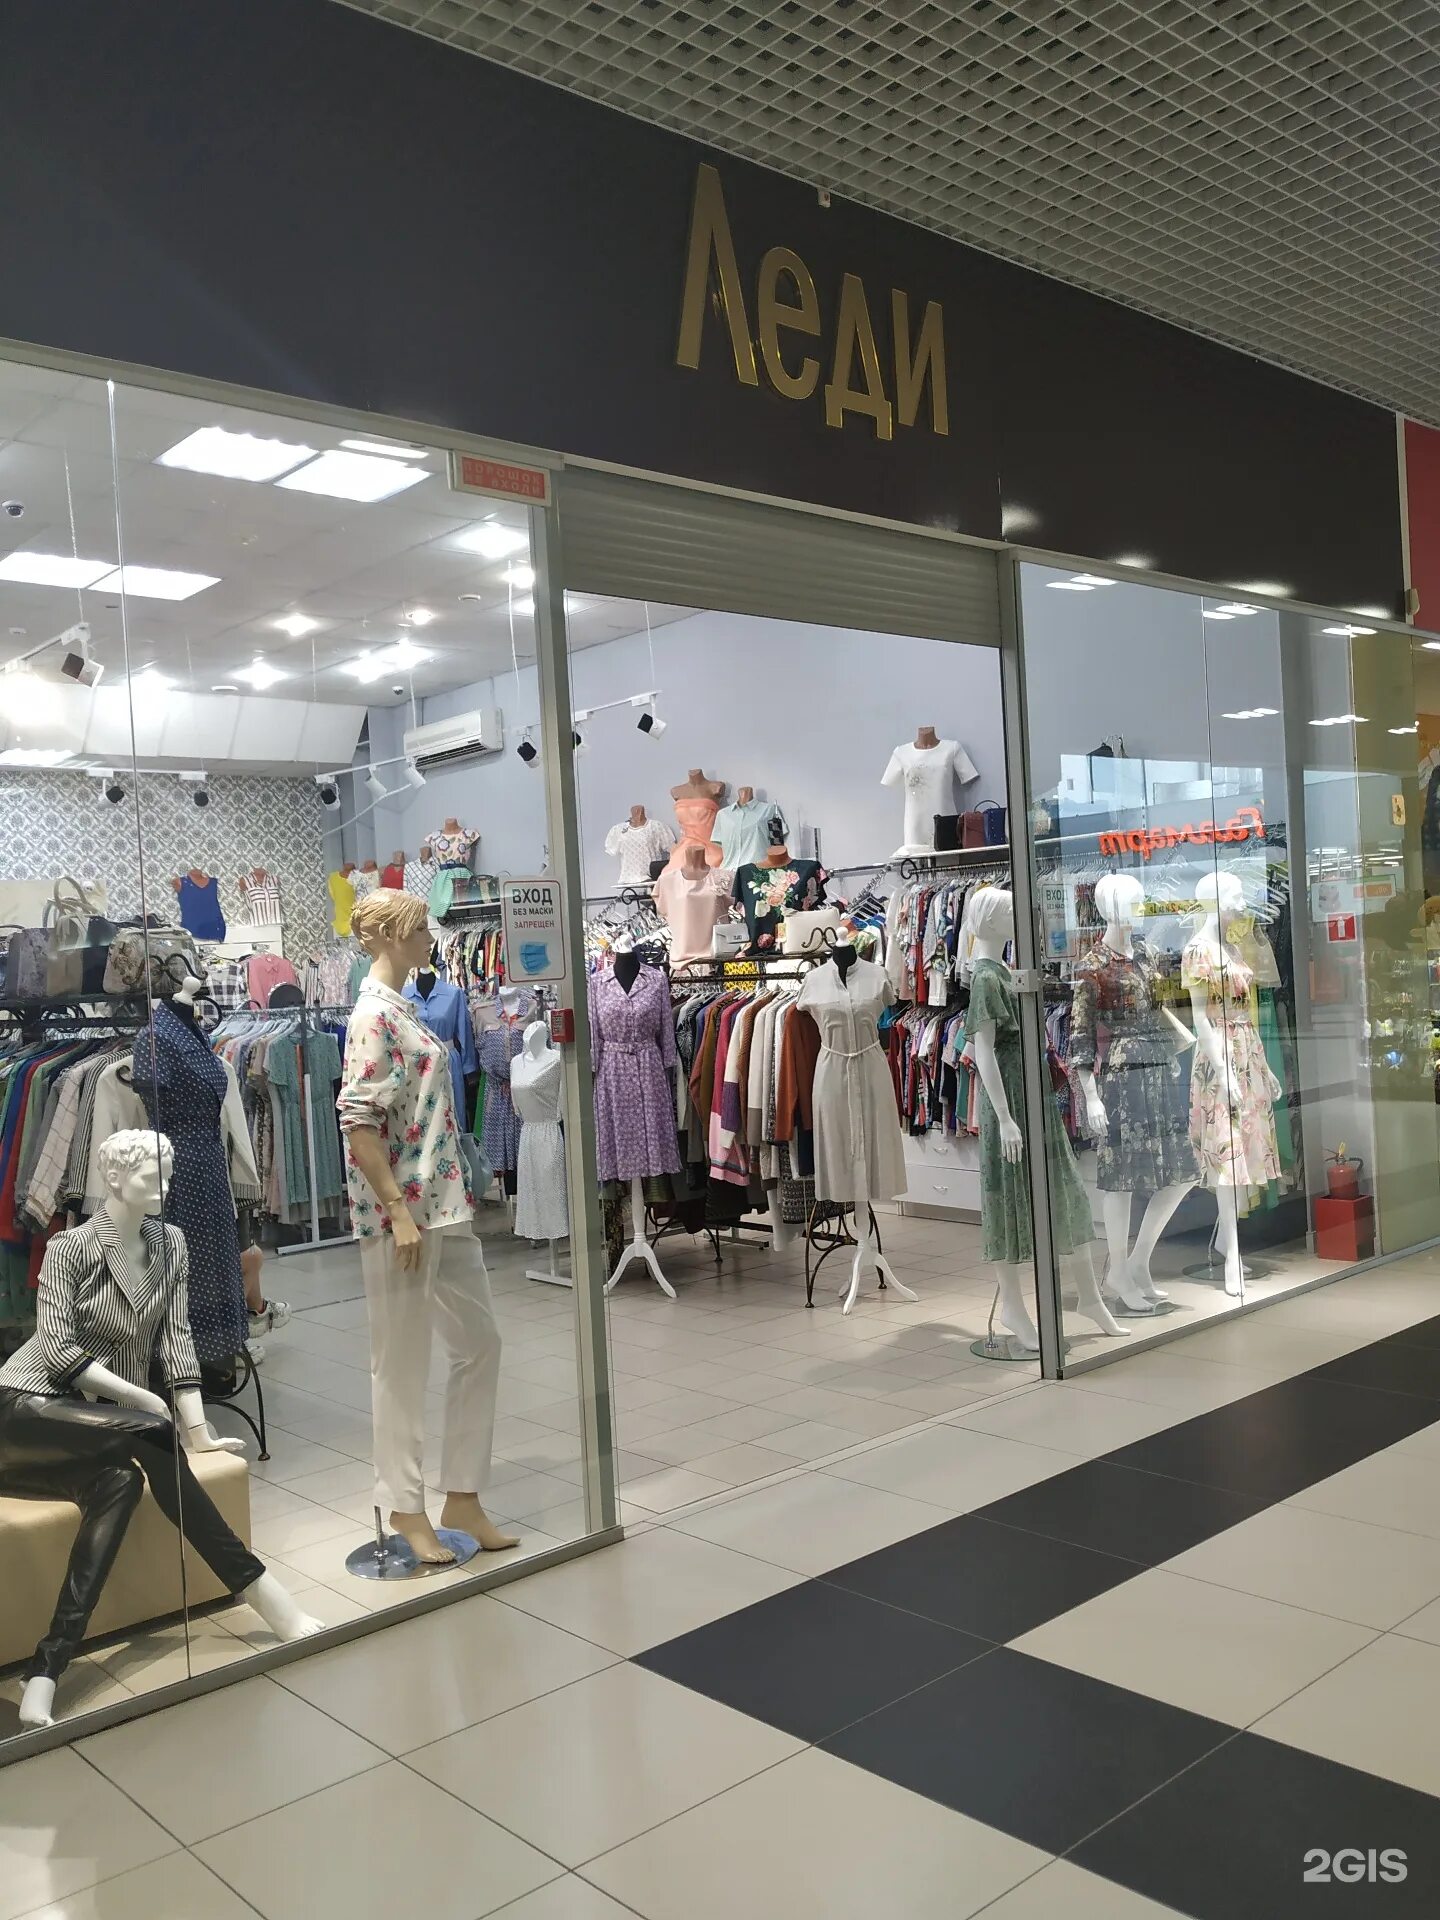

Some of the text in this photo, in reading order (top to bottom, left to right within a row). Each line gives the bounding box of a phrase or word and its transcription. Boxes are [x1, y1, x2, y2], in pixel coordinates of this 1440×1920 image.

[677, 162, 949, 441] Леди
[512, 888, 553, 905] ВХОД
[529, 907, 554, 915] МАСКИ
[514, 920, 555, 929] ЗАПРЕЩЕН
